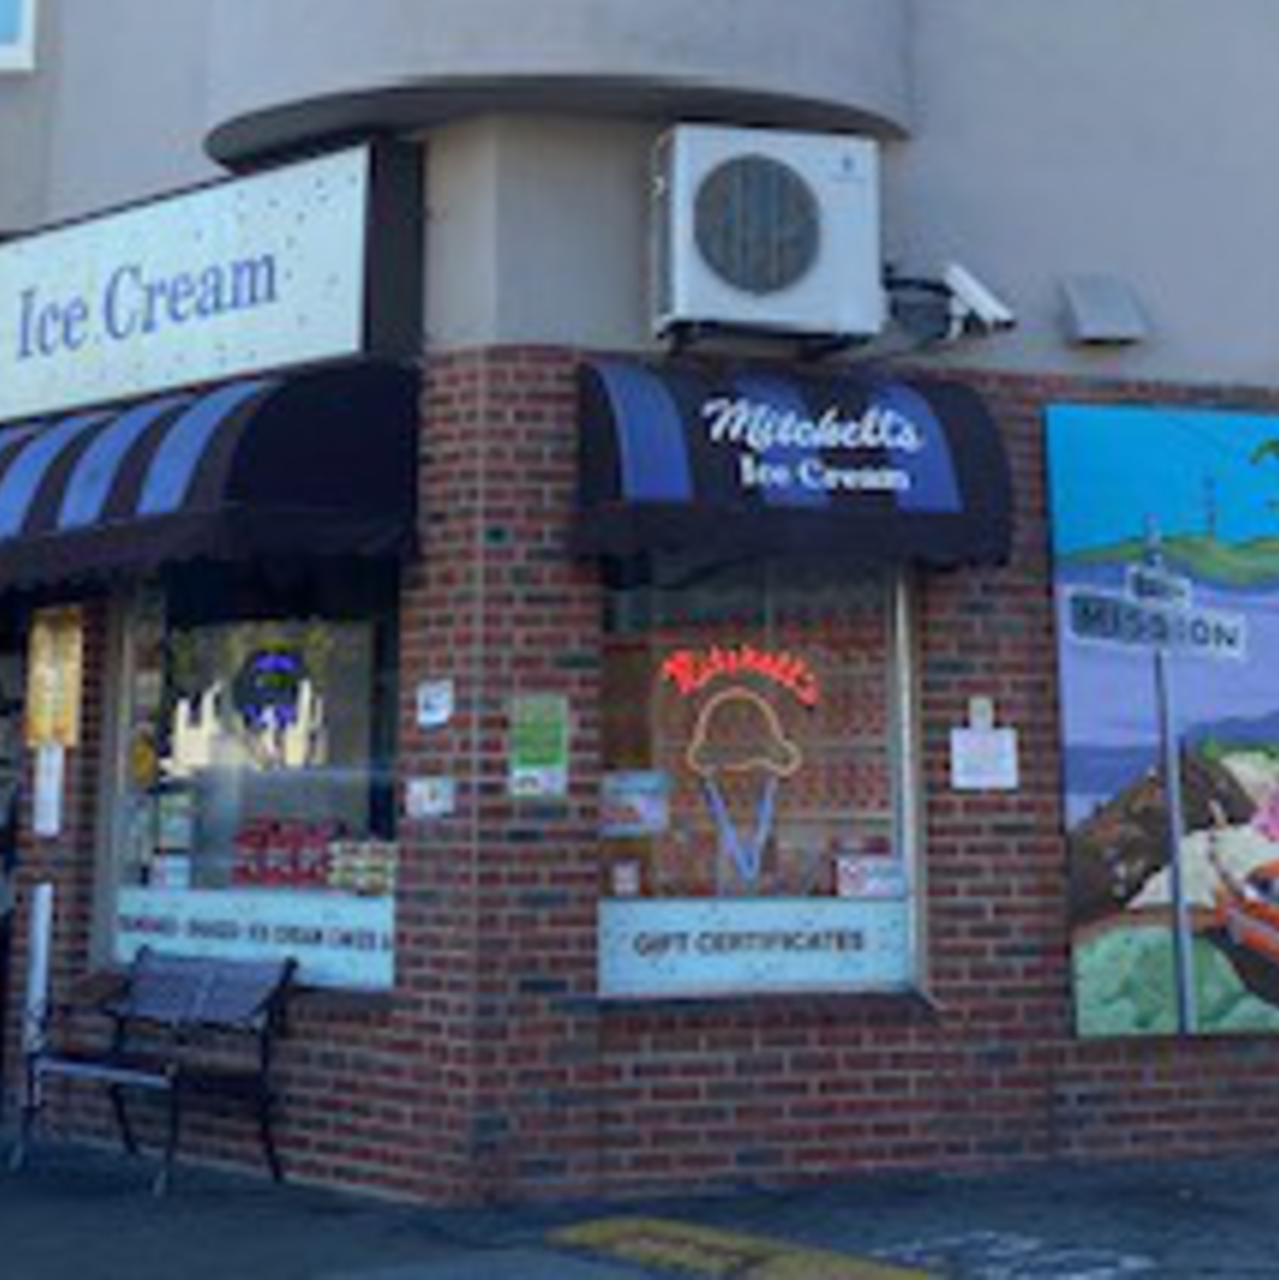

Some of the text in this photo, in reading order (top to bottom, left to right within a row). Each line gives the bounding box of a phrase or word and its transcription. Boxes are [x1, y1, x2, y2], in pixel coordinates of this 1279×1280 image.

[18, 252, 279, 360] Ice Cream
[702, 398, 923, 454] Mitchell's
[740, 454, 911, 491] Ice Cream
[1071, 594, 1239, 646] MISSION
[632, 930, 864, 959] GIFT CERTIFICATES
